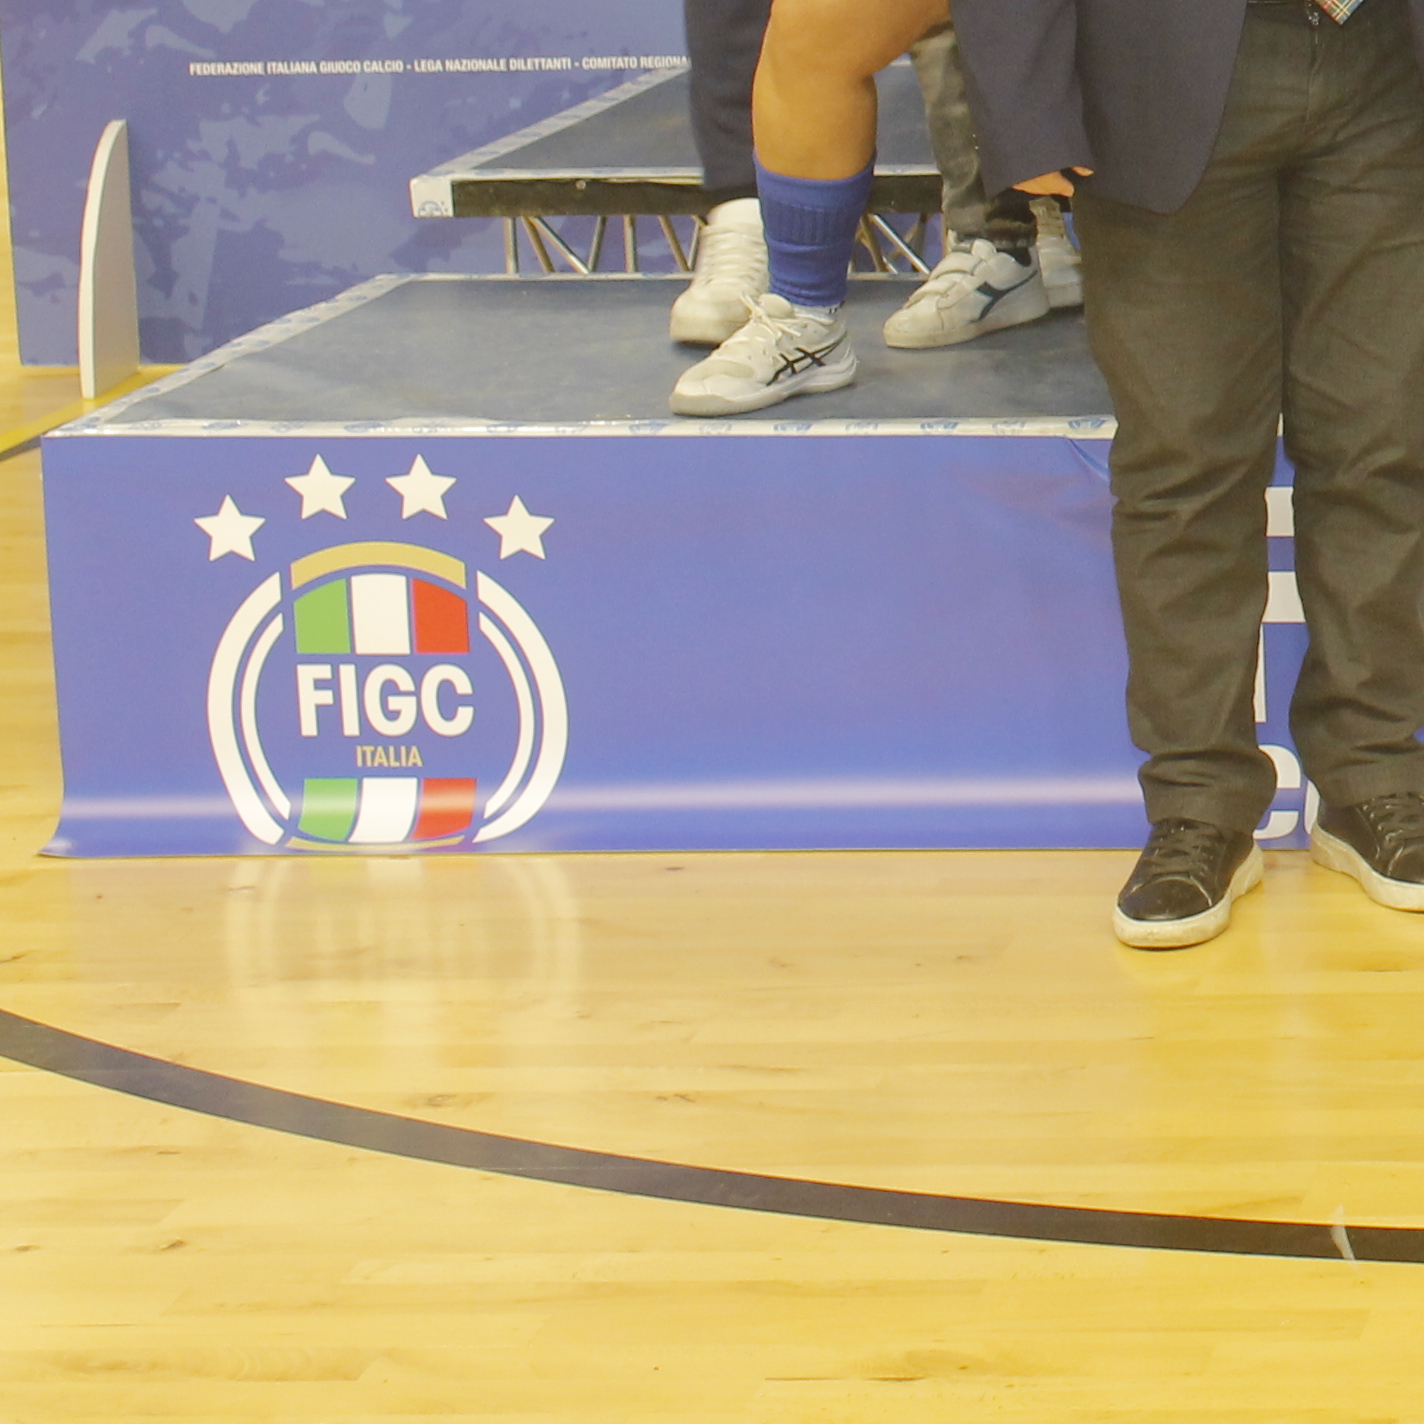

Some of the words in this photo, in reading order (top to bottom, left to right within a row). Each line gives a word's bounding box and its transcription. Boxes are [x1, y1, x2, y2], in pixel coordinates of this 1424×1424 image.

[189, 61, 266, 76] FEDERAZIONE
[267, 60, 318, 75] ITALIANA
[319, 59, 361, 75] GIUOCO
[363, 59, 404, 73] CALCIO
[414, 58, 443, 73] LEGA
[445, 58, 507, 73] NAZIONALE
[509, 57, 572, 72] DILETTANTI
[582, 56, 638, 71] COMITATO
[640, 55, 689, 69] REGIONA
[296, 663, 475, 739] FIGC
[355, 745, 422, 768] ITALIA
